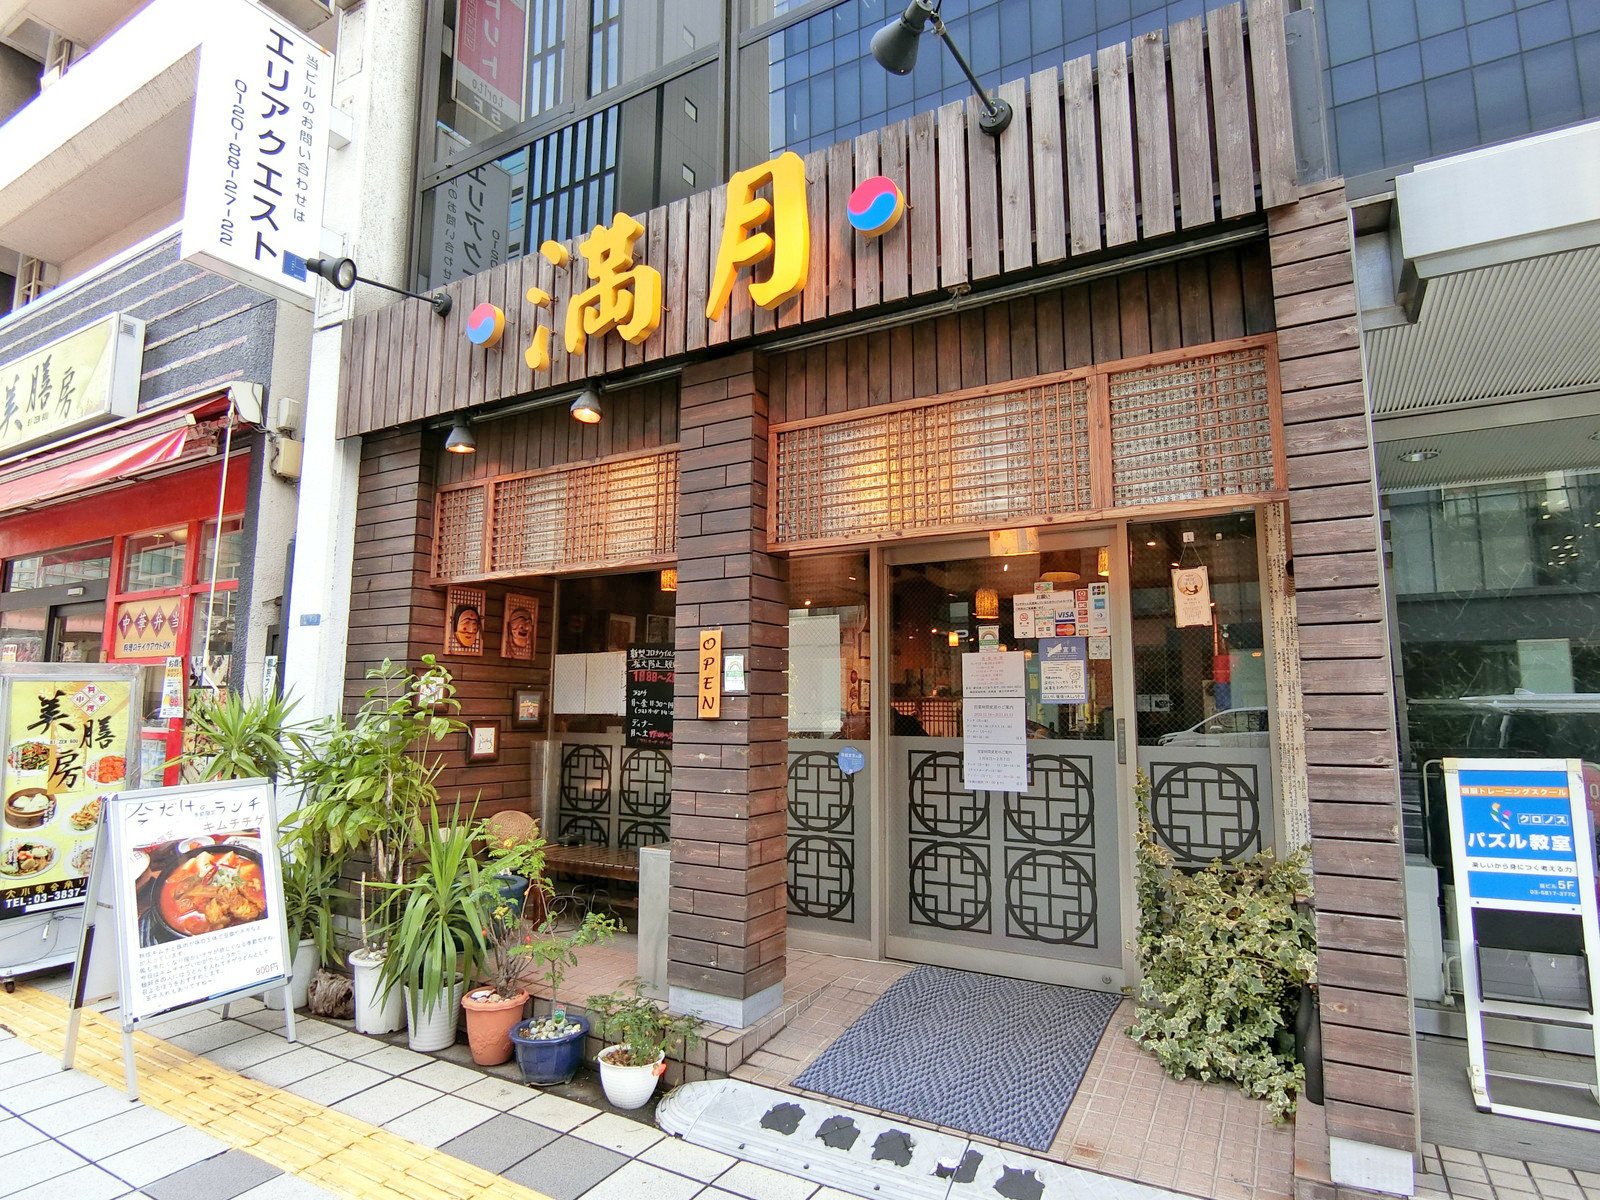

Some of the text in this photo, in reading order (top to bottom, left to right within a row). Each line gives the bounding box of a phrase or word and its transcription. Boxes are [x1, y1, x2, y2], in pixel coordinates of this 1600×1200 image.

[249, 27, 294, 261] エリアクエスト
[292, 53, 319, 223] 当ビルのお問い合わせは
[219, 78, 248, 247] 0120-88-27-22
[524, 150, 811, 373] 満月
[122, 611, 179, 633] 中華弁当
[702, 636, 718, 711] OPEN
[203, 814, 266, 832] キムチチゲ
[1518, 814, 1568, 825] クロノス
[1467, 831, 1572, 852] パズル教室
[1472, 861, 1573, 873] 楽しいから身につく考える力
[1558, 880, 1575, 890] 5F
[255, 962, 279, 976] 900円
